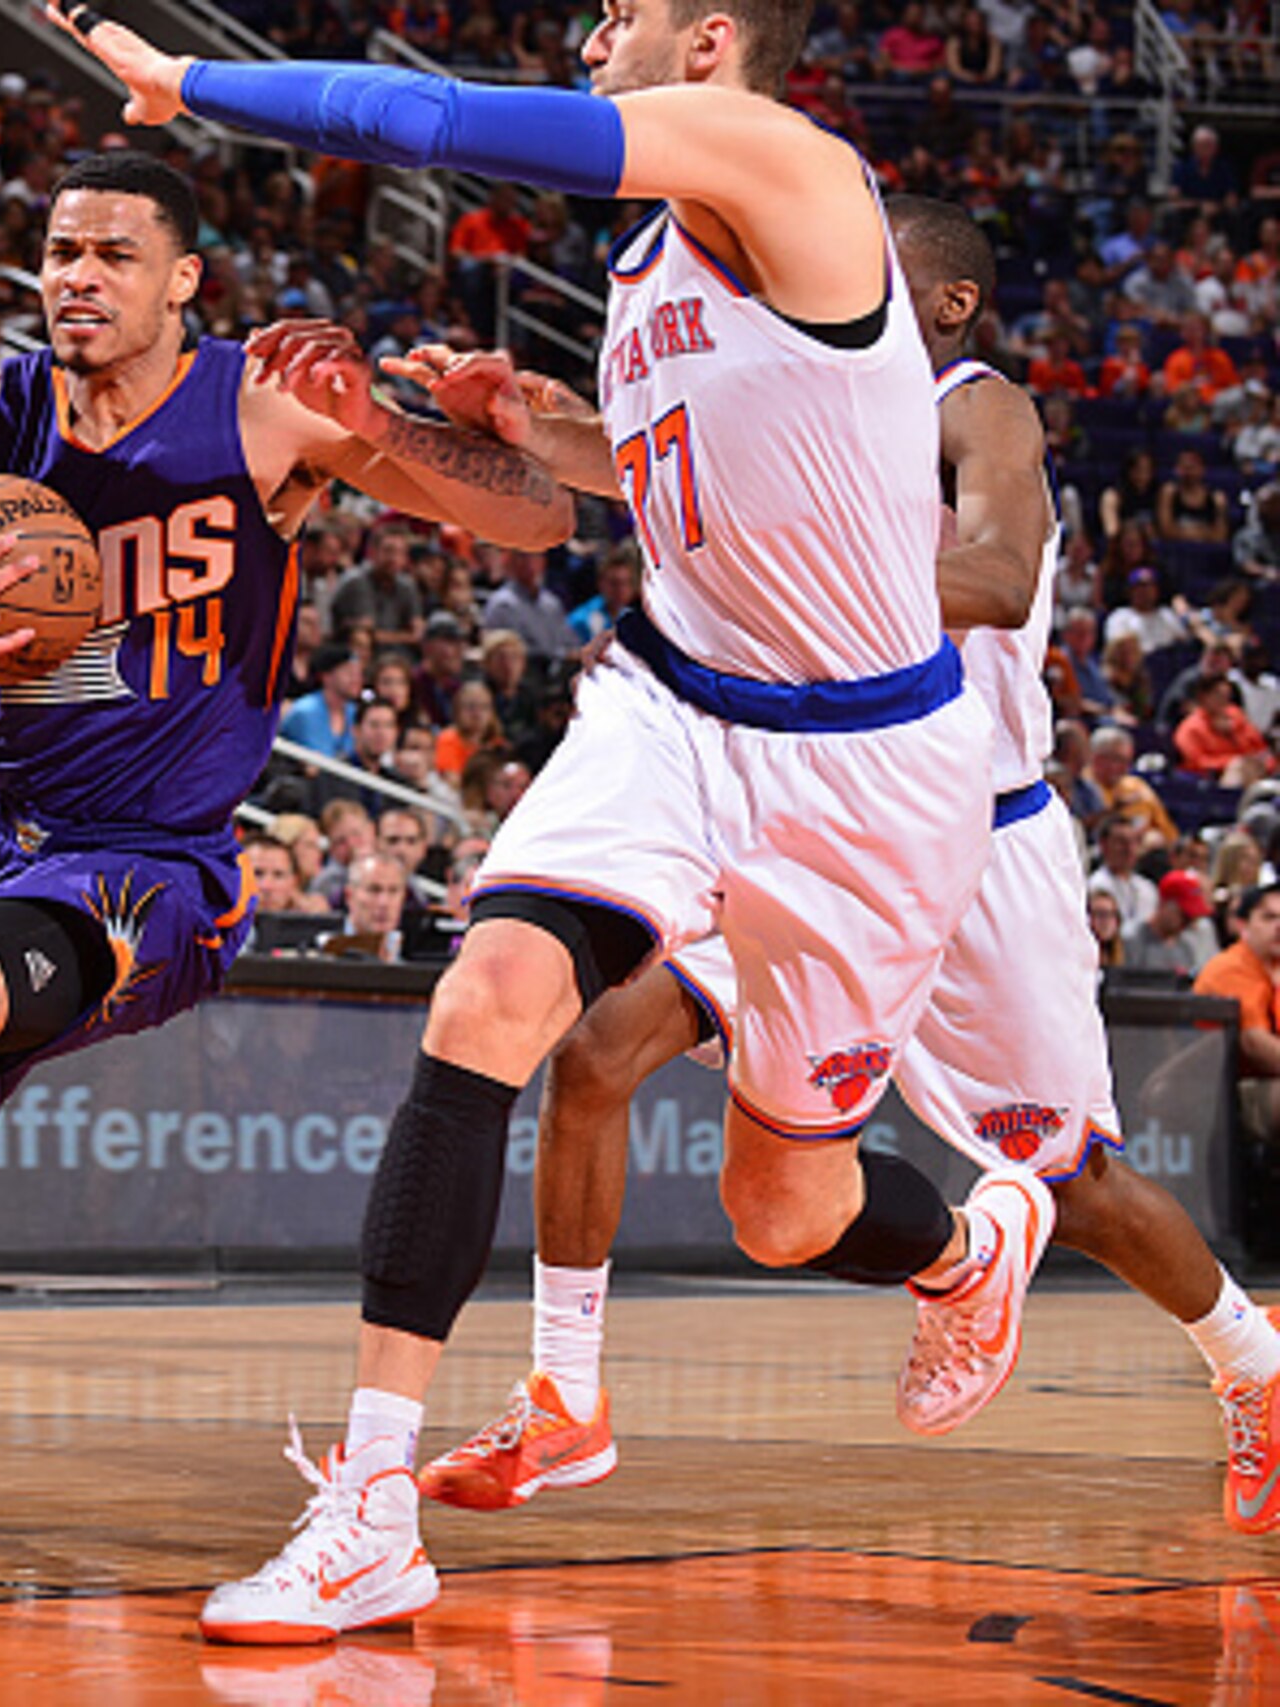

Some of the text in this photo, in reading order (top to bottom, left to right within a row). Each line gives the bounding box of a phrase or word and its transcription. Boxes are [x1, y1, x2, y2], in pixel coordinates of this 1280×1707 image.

[614, 400, 705, 569] 77
[149, 597, 225, 699] 14
[1128, 1117, 1191, 1173] du
